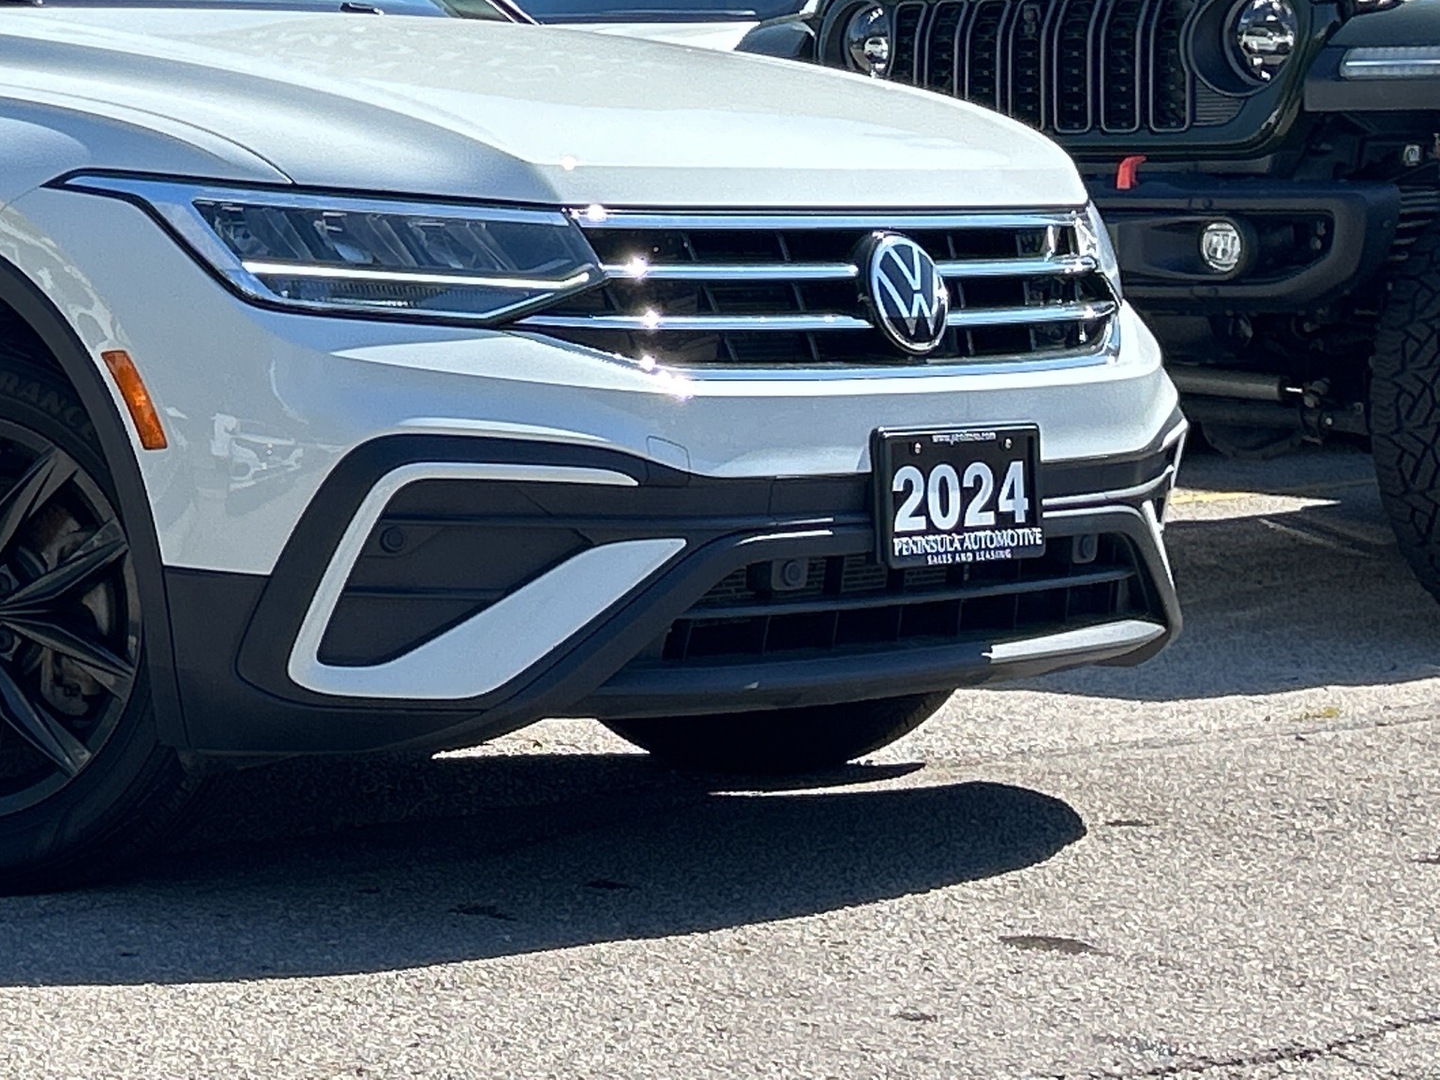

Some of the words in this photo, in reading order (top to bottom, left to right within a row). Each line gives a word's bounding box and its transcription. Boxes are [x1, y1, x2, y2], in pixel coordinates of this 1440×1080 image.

[892, 461, 1029, 532] 2024
[893, 533, 963, 556] PENINSULA
[963, 528, 1042, 551] AUTOMOTIVE
[926, 553, 953, 565] SALES
[955, 552, 973, 563] AND
[975, 548, 1012, 562] LEASING
